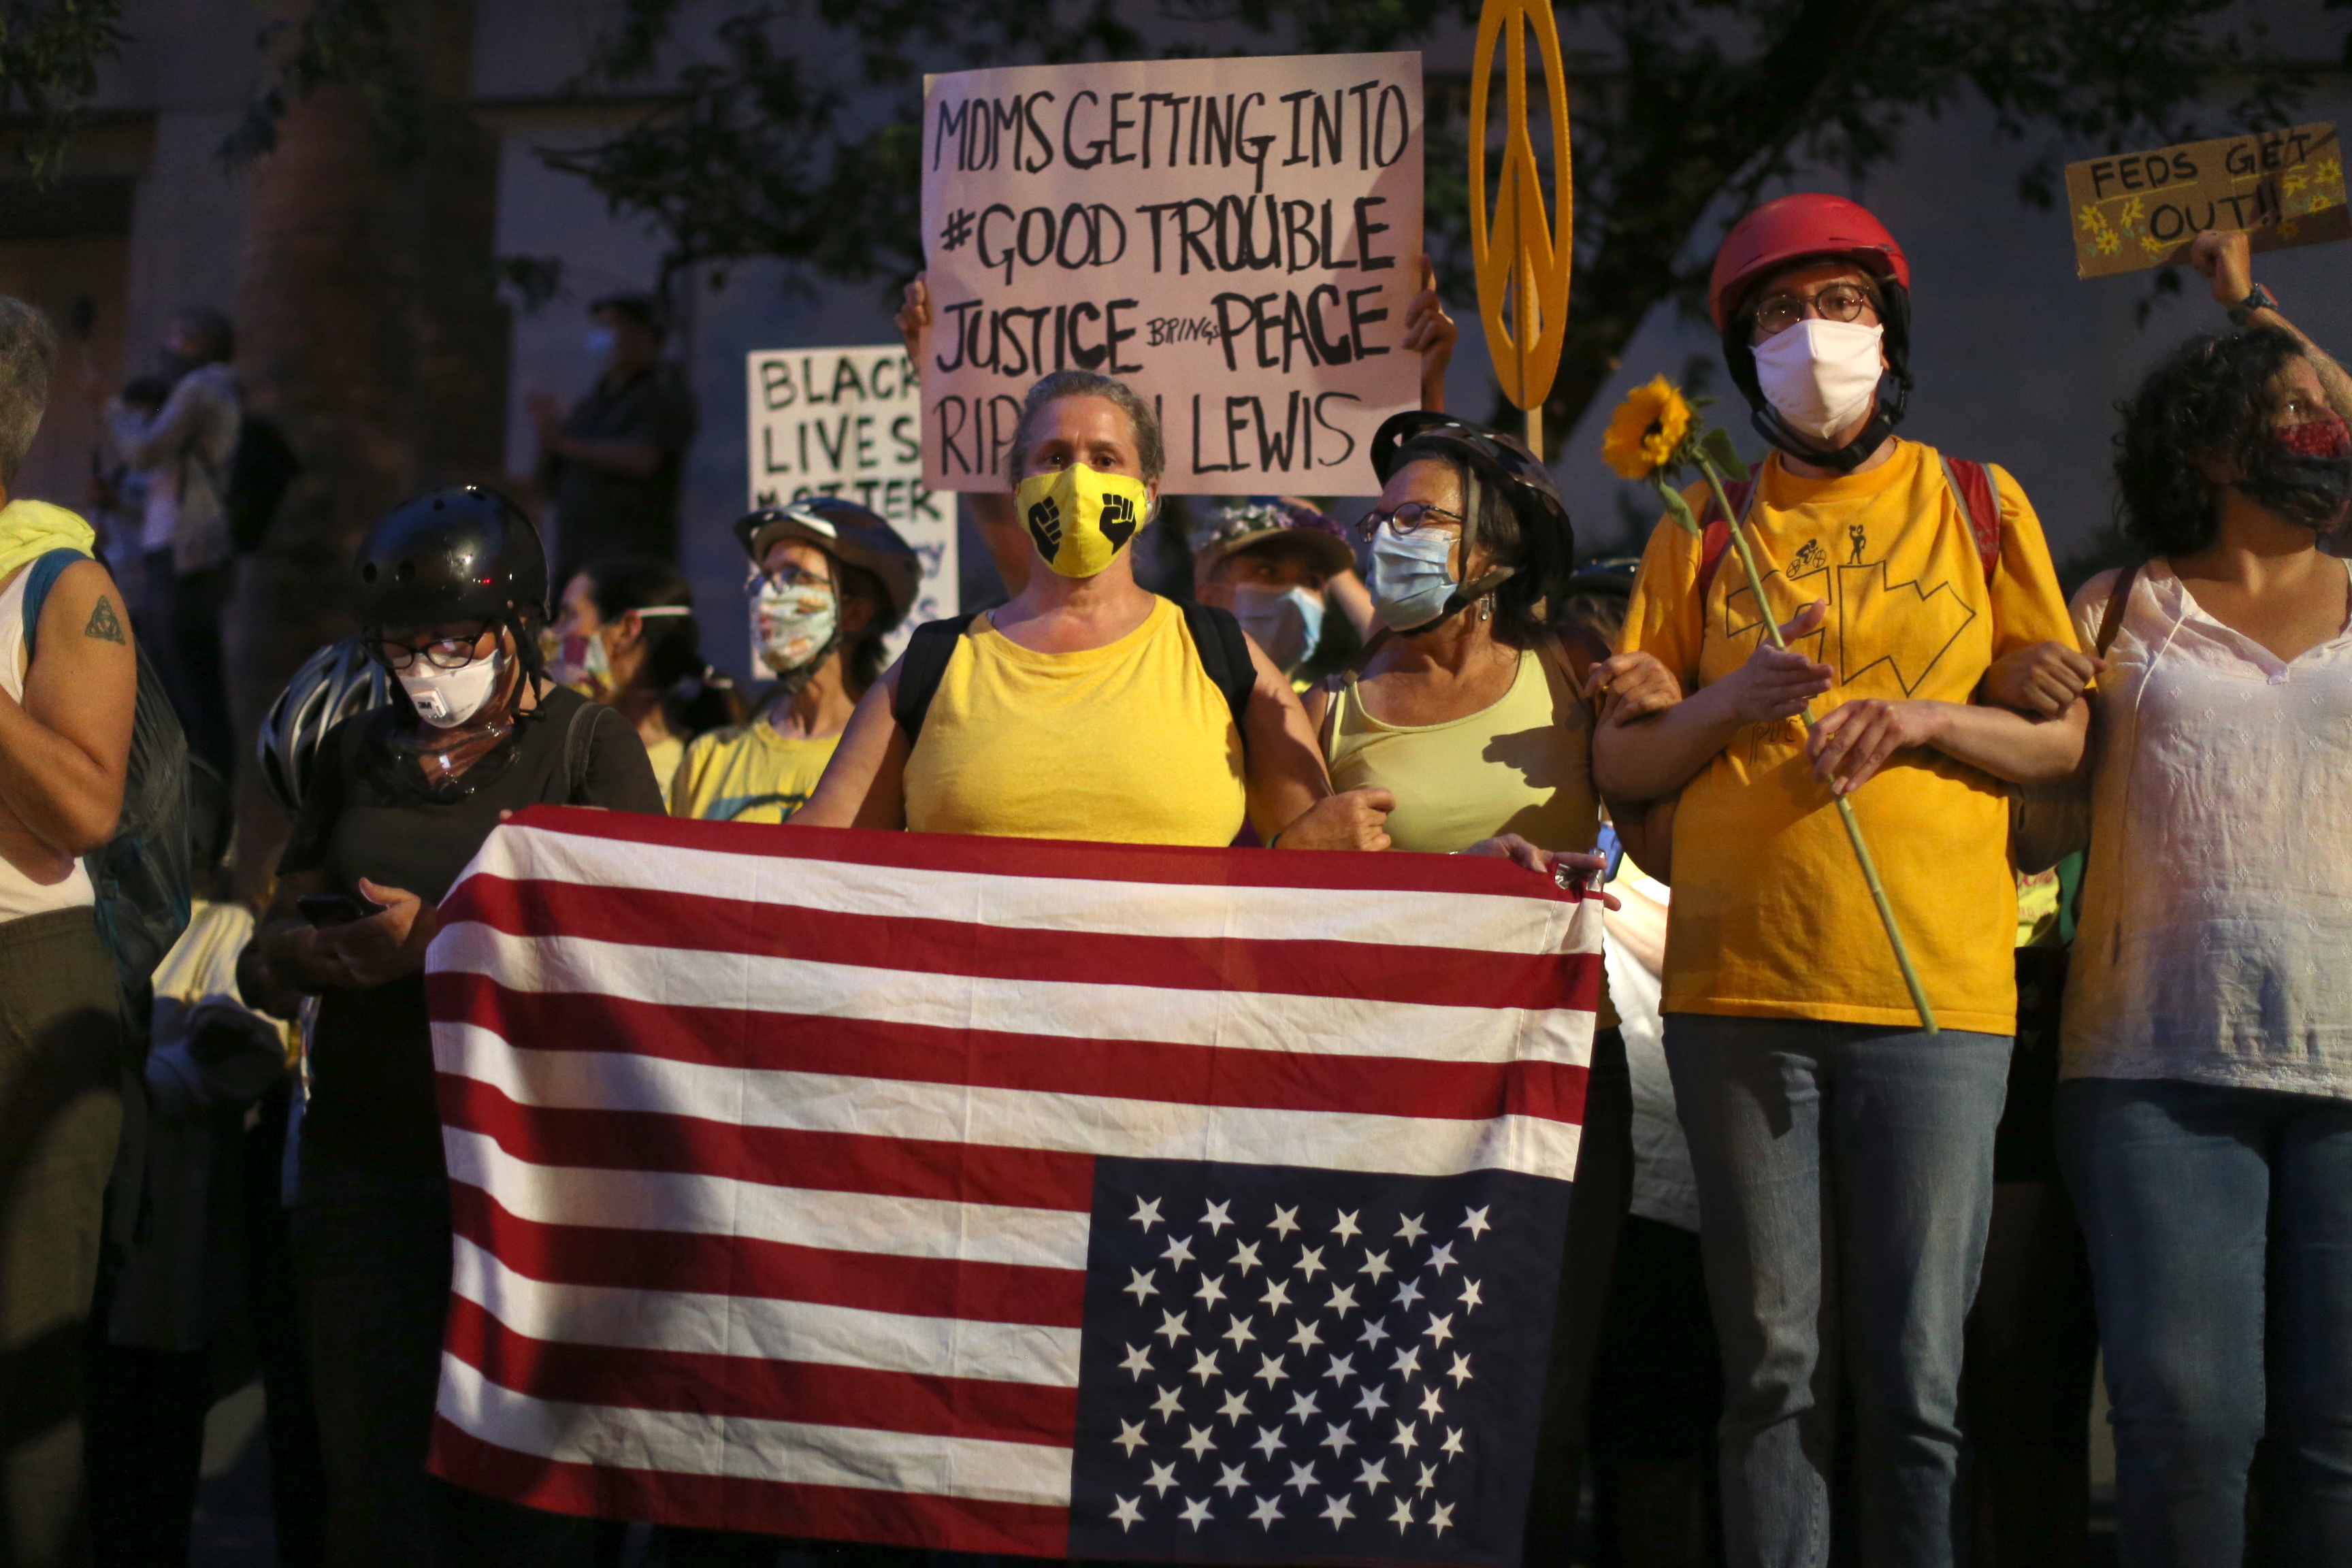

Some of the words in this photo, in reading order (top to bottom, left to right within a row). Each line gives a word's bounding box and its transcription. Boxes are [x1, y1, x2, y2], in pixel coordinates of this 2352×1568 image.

[933, 90, 1055, 174] MOMS
[1063, 90, 1277, 194] GETTING
[2091, 152, 2198, 199] FEDS
[2225, 133, 2312, 176] GET
[940, 203, 1127, 287] #GOOD
[1135, 193, 1396, 276] TROUBLE
[936, 297, 1144, 377] JUSTICE
[1146, 316, 1220, 346] BRINGS
[1211, 283, 1391, 374] PEACE
[764, 414, 921, 474] LIVES
[933, 394, 1021, 475] RIP
[1192, 390, 1361, 475] LEWIS
